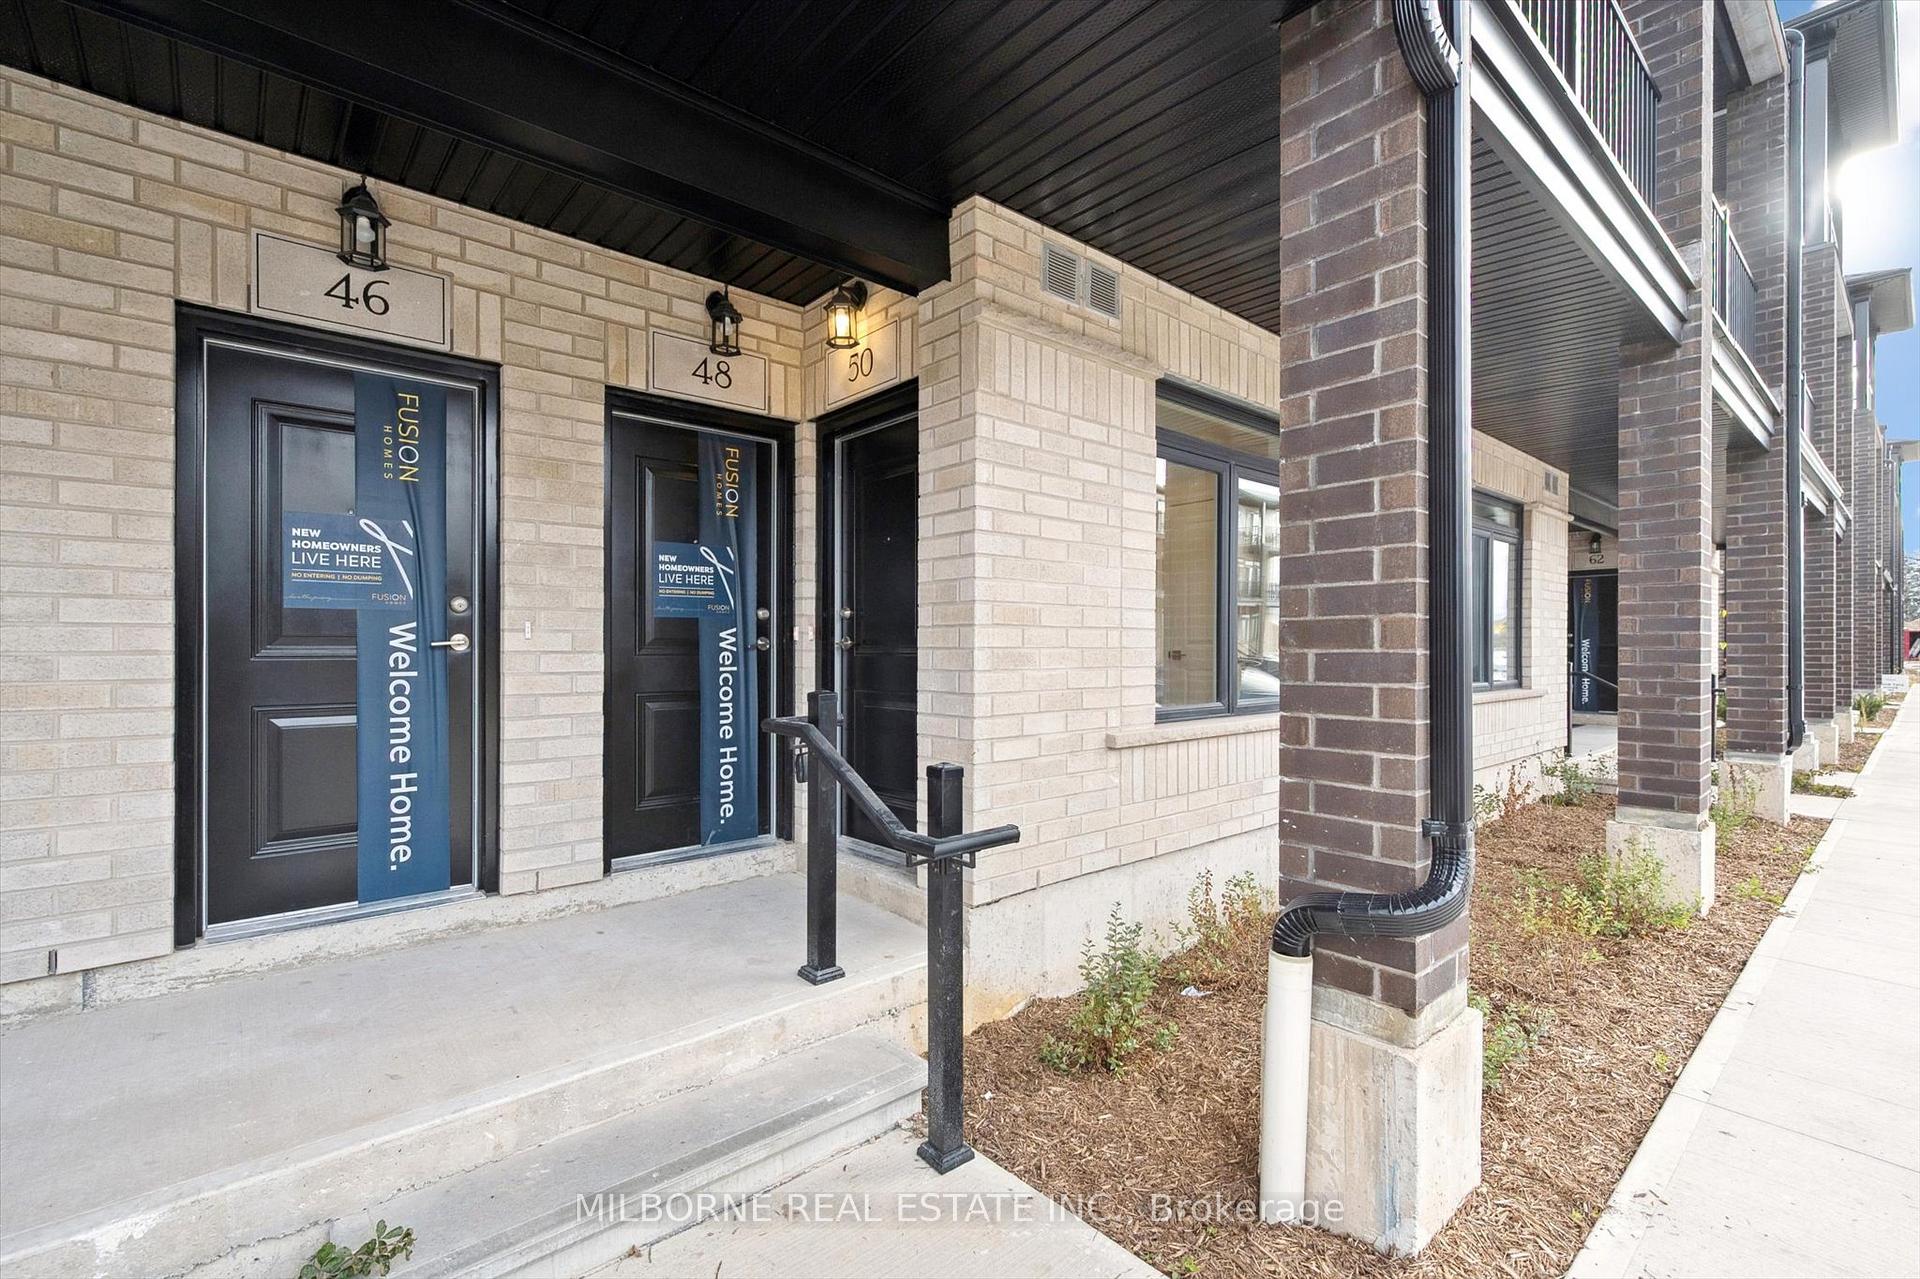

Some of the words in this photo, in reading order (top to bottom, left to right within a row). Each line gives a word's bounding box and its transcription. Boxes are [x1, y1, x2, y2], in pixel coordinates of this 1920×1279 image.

[323, 272, 391, 316] 46
[691, 357, 733, 389] 48
[848, 347, 874, 382] 50
[383, 425, 393, 480] HOMES
[397, 392, 420, 482] FUSION
[725, 447, 740, 518] FUSION
[291, 527, 321, 538] NEW
[291, 539, 382, 554] HOMEOWNERS
[291, 551, 331, 566] LIVE
[335, 554, 382, 569] HERE
[658, 554, 678, 562] NEW
[658, 563, 714, 574] HOMEOWNERS
[1589, 554, 1605, 565] 62
[371, 593, 407, 601] FUSION
[658, 573, 683, 584] LIVE
[685, 575, 714, 586] HERE
[1581, 639, 1591, 675] Welcom
[388, 621, 418, 764] Welcome
[719, 627, 737, 740] Welcome
[719, 746, 738, 825] Home.
[389, 772, 418, 871] Home.
